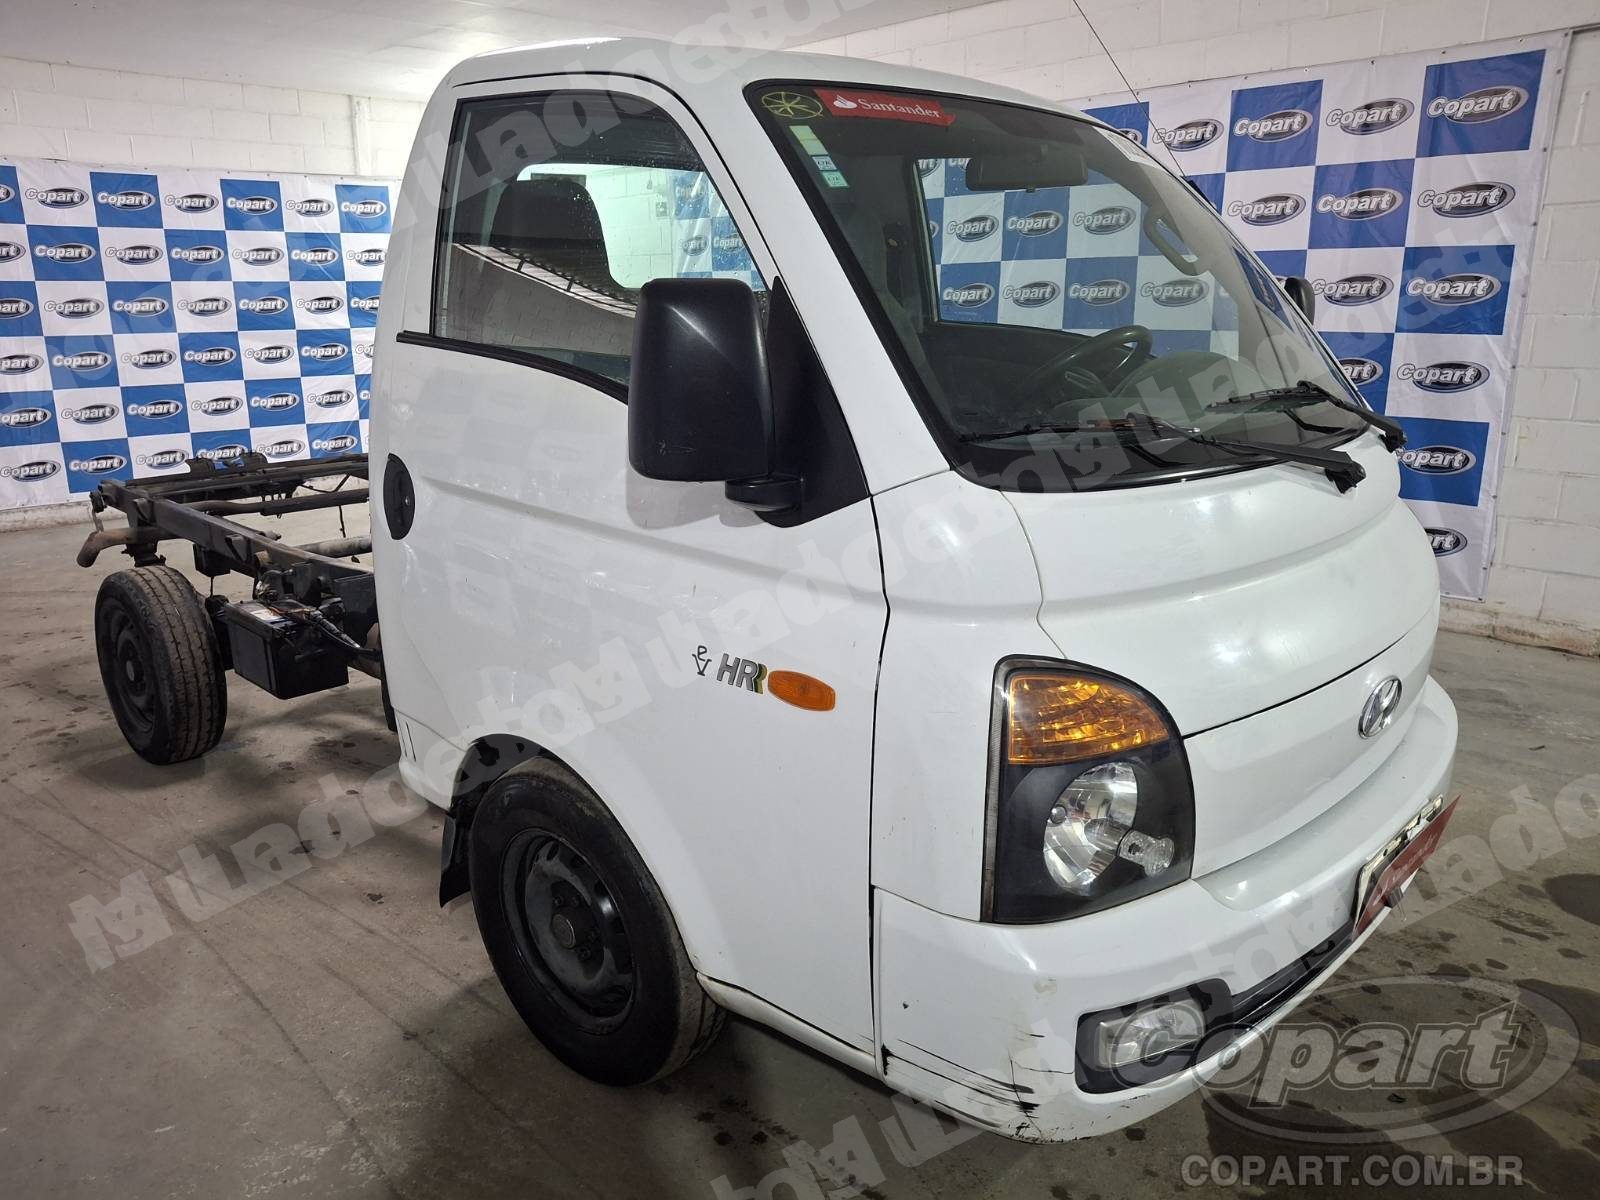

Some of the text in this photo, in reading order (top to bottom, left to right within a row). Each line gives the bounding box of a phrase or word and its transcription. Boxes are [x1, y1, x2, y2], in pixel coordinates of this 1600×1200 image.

[858, 98, 940, 118] Santander
[1427, 89, 1515, 119] Copart
[1326, 103, 1403, 127] Copart
[1233, 116, 1302, 139] Copart
[1152, 124, 1213, 146] Copart
[25, 188, 81, 203] Copart
[98, 192, 149, 206] Copart
[165, 195, 211, 208] Copart
[1316, 189, 1391, 215] Copart
[1417, 186, 1502, 210] Copart
[226, 197, 271, 211] Copart
[286, 200, 328, 212] Copart
[341, 201, 381, 214] Copart
[1227, 199, 1294, 220] Copart
[1007, 214, 1057, 231] Copart
[1073, 209, 1126, 228] Copart
[947, 218, 992, 236] Copart
[35, 245, 89, 259] Copart
[105, 247, 155, 260] Copart
[171, 248, 217, 261] Copart
[232, 249, 276, 262] Copart
[291, 250, 332, 262] Copart
[943, 286, 989, 301] Copart
[1002, 284, 1052, 301] Copart
[1069, 283, 1123, 300] Copart
[1141, 282, 1199, 298] Copart
[1312, 279, 1381, 297] Copart
[1406, 277, 1489, 298] Copart
[44, 300, 97, 315] Copart
[112, 300, 162, 313] Copart
[177, 301, 225, 313] Copart
[239, 299, 283, 312] Copart
[296, 299, 338, 311] Copart
[351, 298, 379, 310] Copa
[121, 352, 169, 365] Copart
[184, 350, 231, 363] Copart
[245, 348, 288, 361] Copart
[301, 345, 342, 358] Copart
[0, 357, 35, 371] part
[52, 354, 106, 368] Copart
[1344, 361, 1371, 378] art
[1397, 363, 1475, 383] Copart
[251, 395, 295, 408] Copart
[307, 392, 348, 404] Copart
[61, 406, 112, 420] Copart
[127, 403, 176, 417] Copart
[192, 399, 237, 413] Copart
[0, 410, 44, 425] opart
[256, 441, 299, 453] Copart
[311, 438, 352, 449] Copart
[70, 457, 120, 472] Copart
[136, 452, 183, 465] Copart
[1397, 449, 1465, 469] opart
[1, 463, 53, 478] Copart
